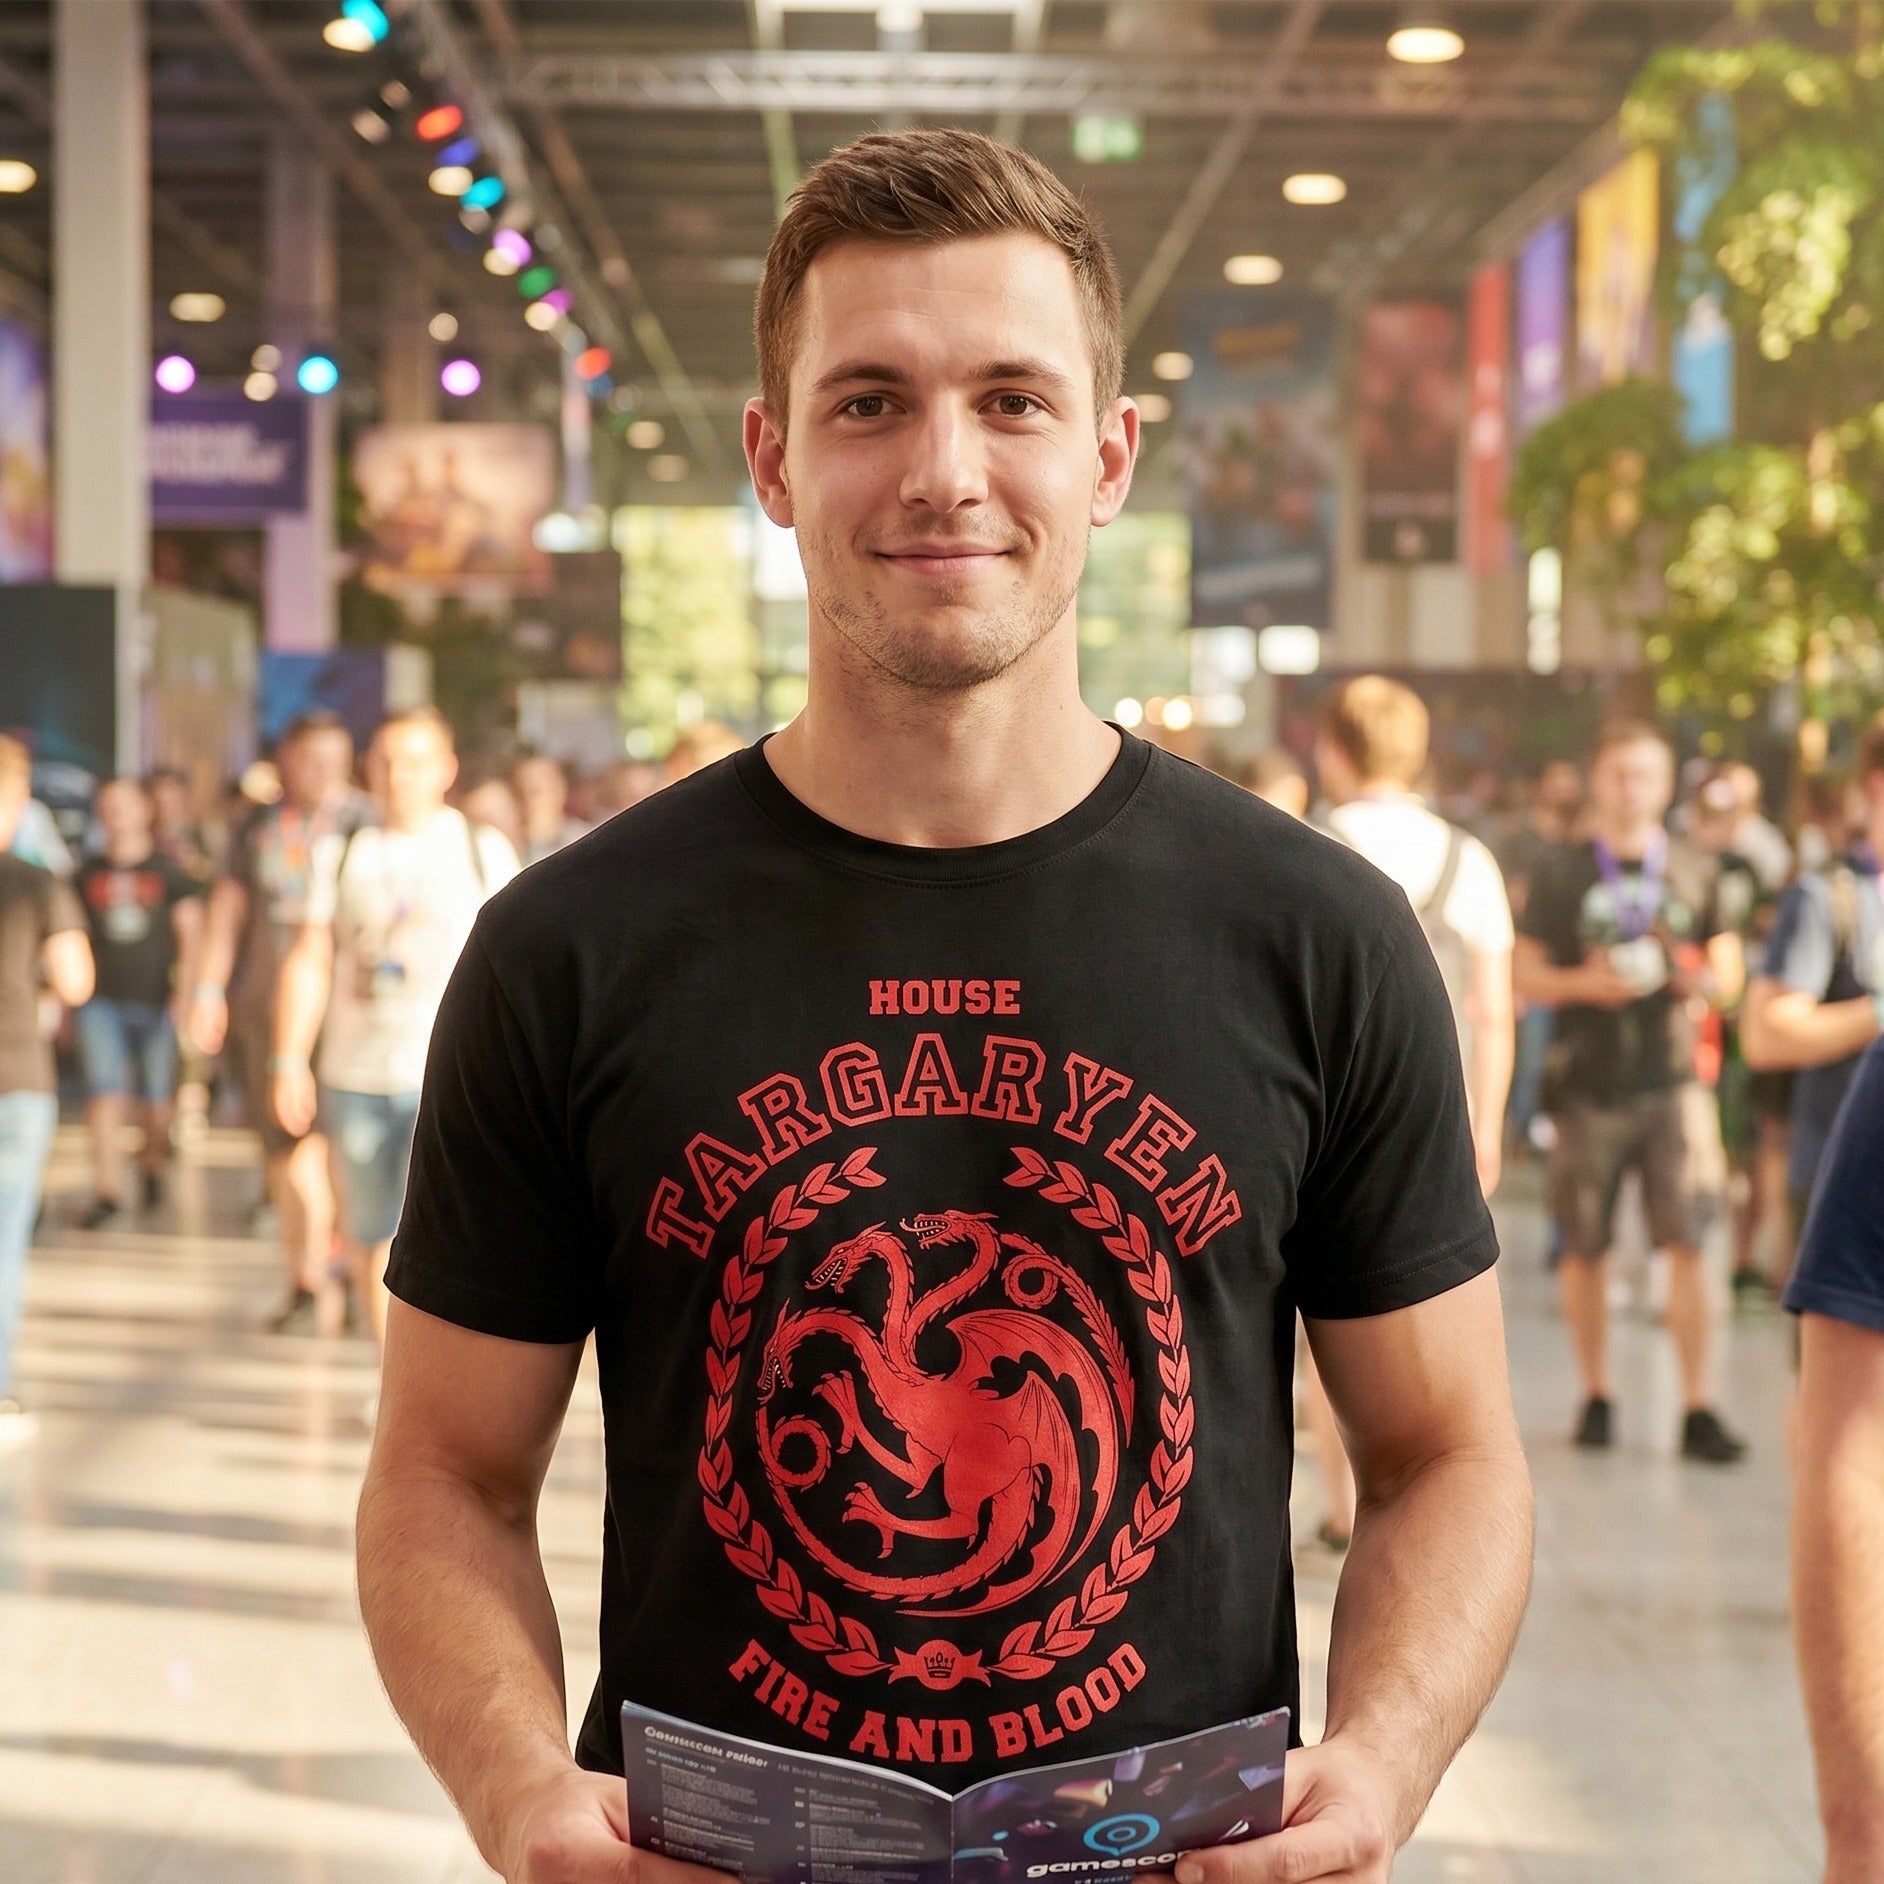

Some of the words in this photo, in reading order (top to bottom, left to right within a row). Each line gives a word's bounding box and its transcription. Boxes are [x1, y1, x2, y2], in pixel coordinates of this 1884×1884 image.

[868, 979, 1021, 1015] HOUSE
[645, 1032, 1242, 1258] TARGARYEN
[728, 1638, 841, 1741] FIRE
[849, 1710, 974, 1763] AND
[988, 1642, 1147, 1759] BLOOD
